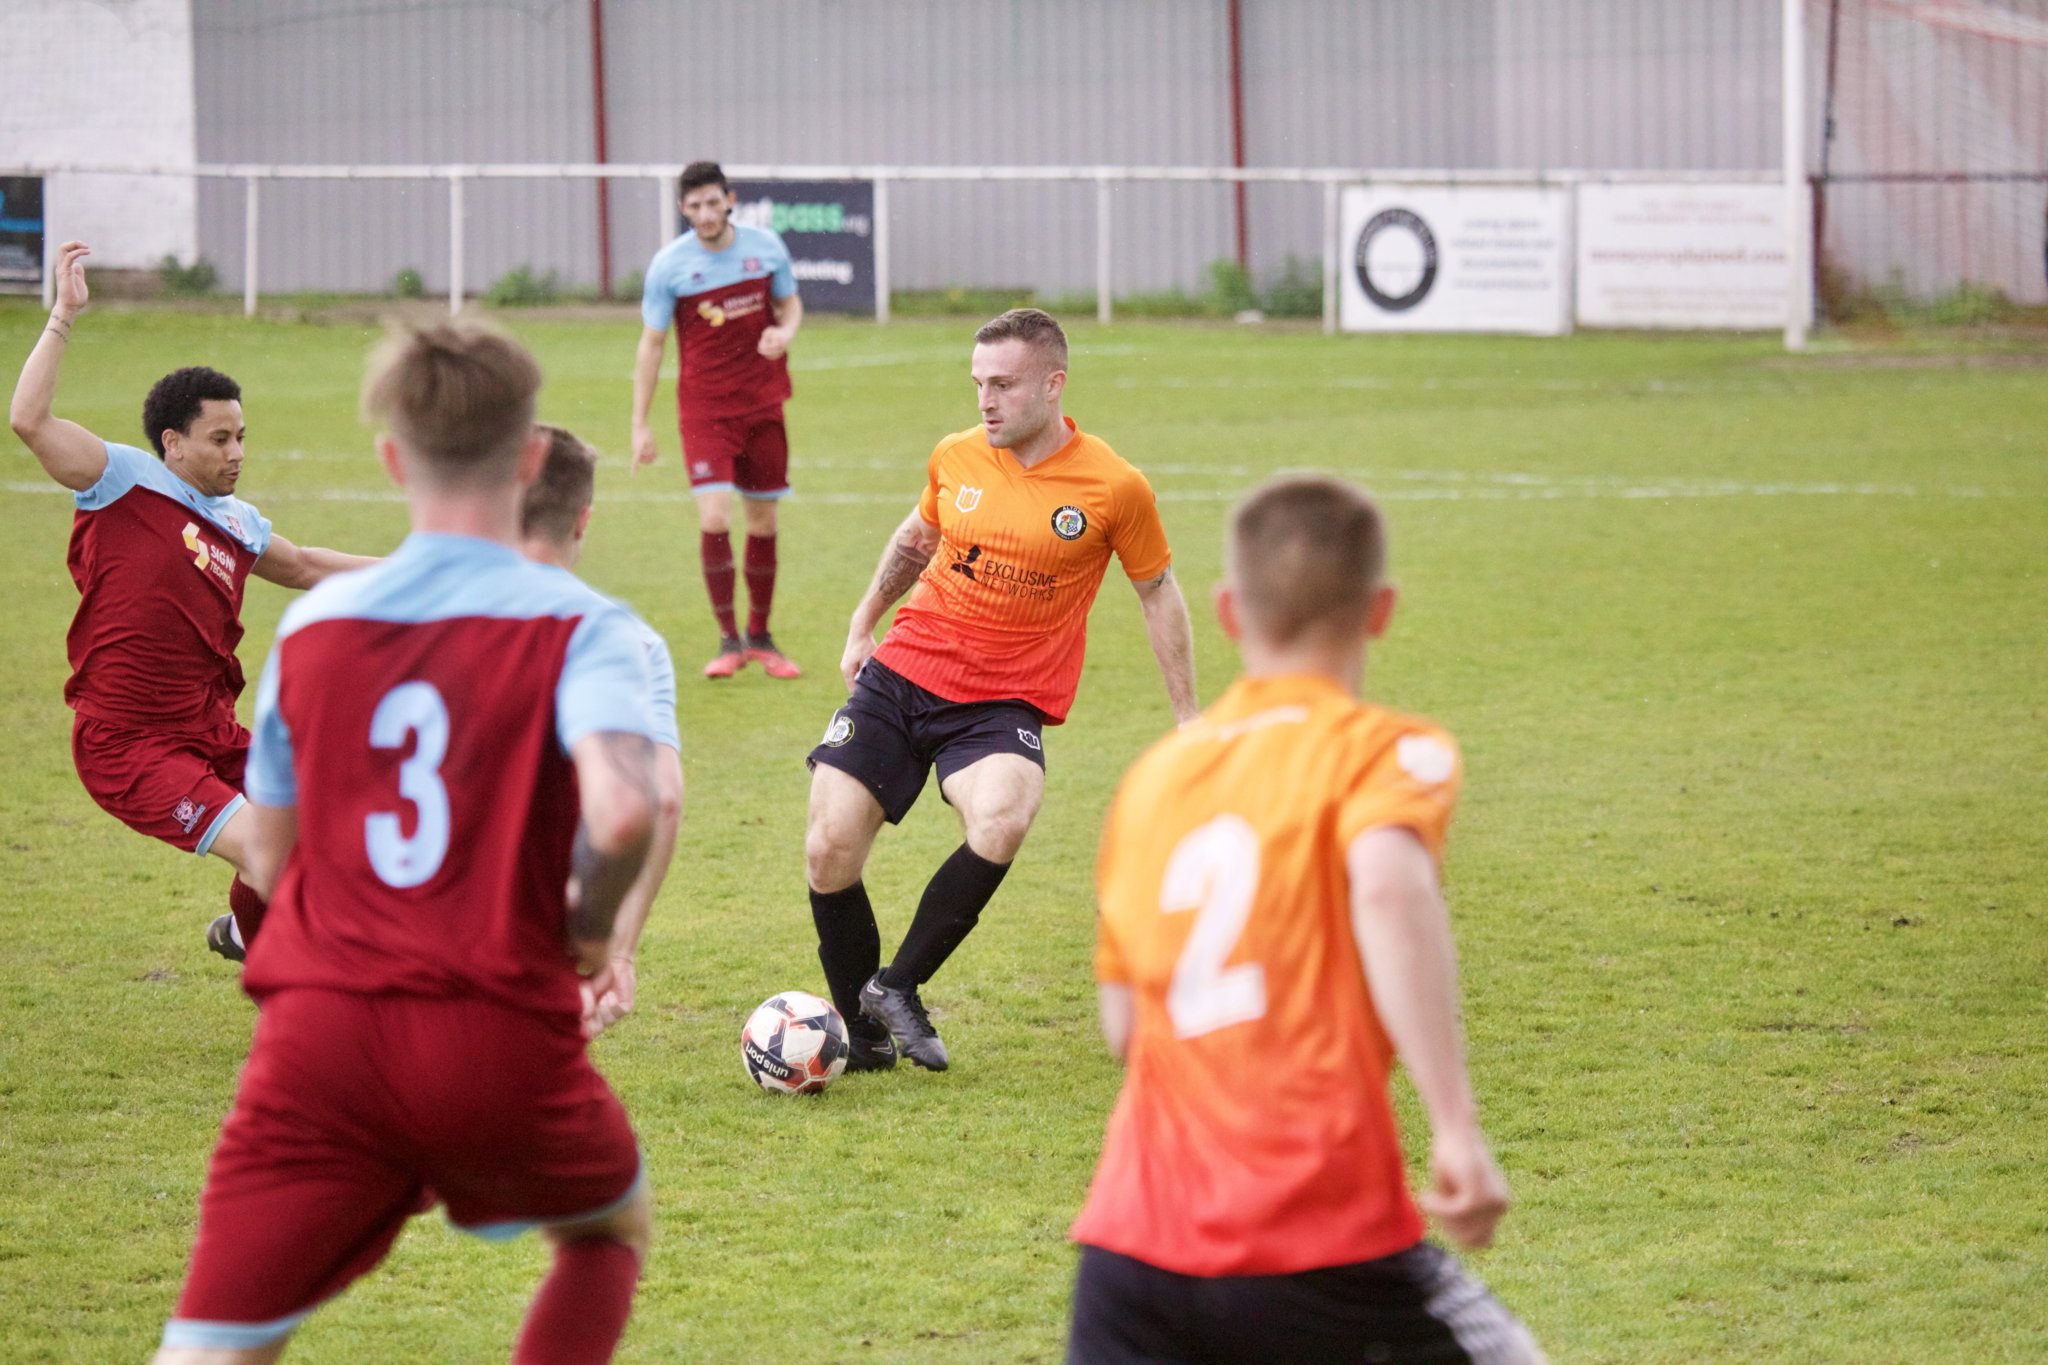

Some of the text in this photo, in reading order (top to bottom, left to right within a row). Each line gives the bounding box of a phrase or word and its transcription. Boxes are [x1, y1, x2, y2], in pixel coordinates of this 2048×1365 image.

[979, 576, 1054, 601] NETWORKS
[984, 560, 1057, 588] EXCLUSIVE
[365, 679, 451, 889] 3
[1159, 812, 1267, 1040] 2
